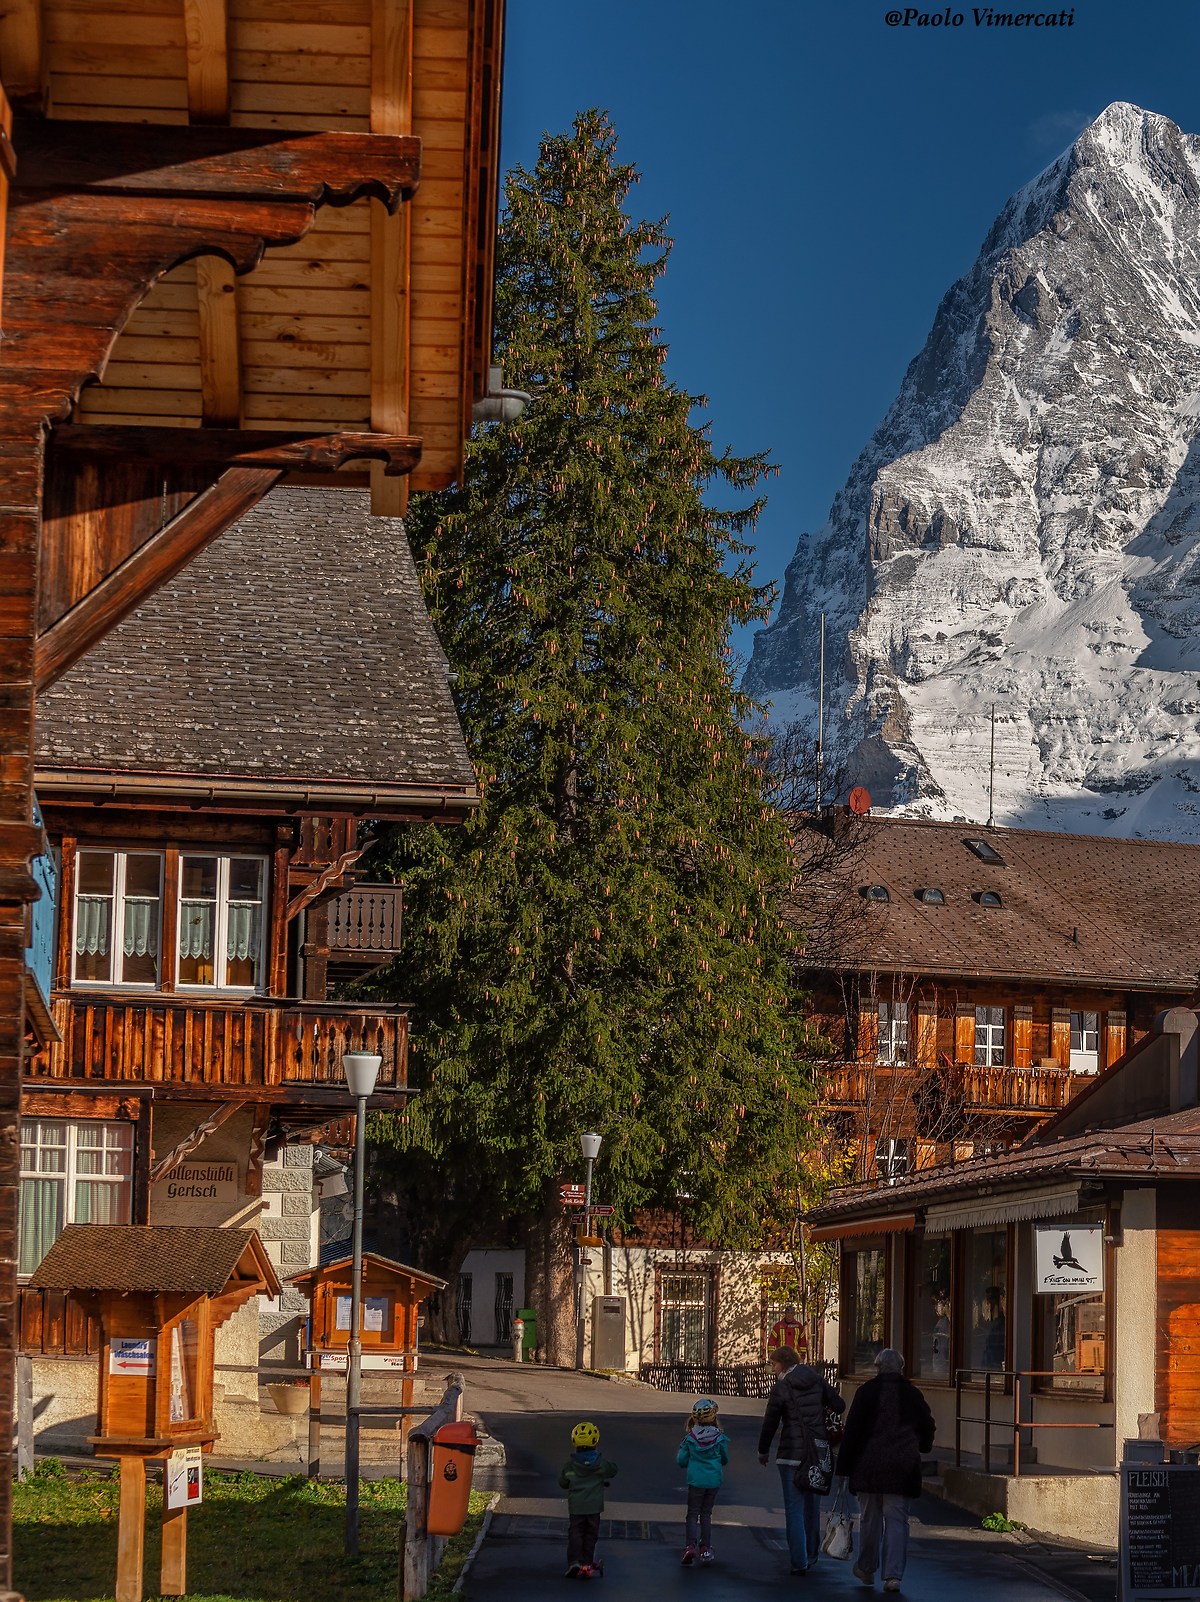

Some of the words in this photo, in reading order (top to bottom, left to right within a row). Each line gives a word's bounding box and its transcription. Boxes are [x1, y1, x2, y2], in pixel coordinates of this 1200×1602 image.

[168, 1183, 216, 1198] Gertsch
[114, 1351, 154, 1359] Waschsalon
[1128, 1471, 1169, 1487] FLEISCH
